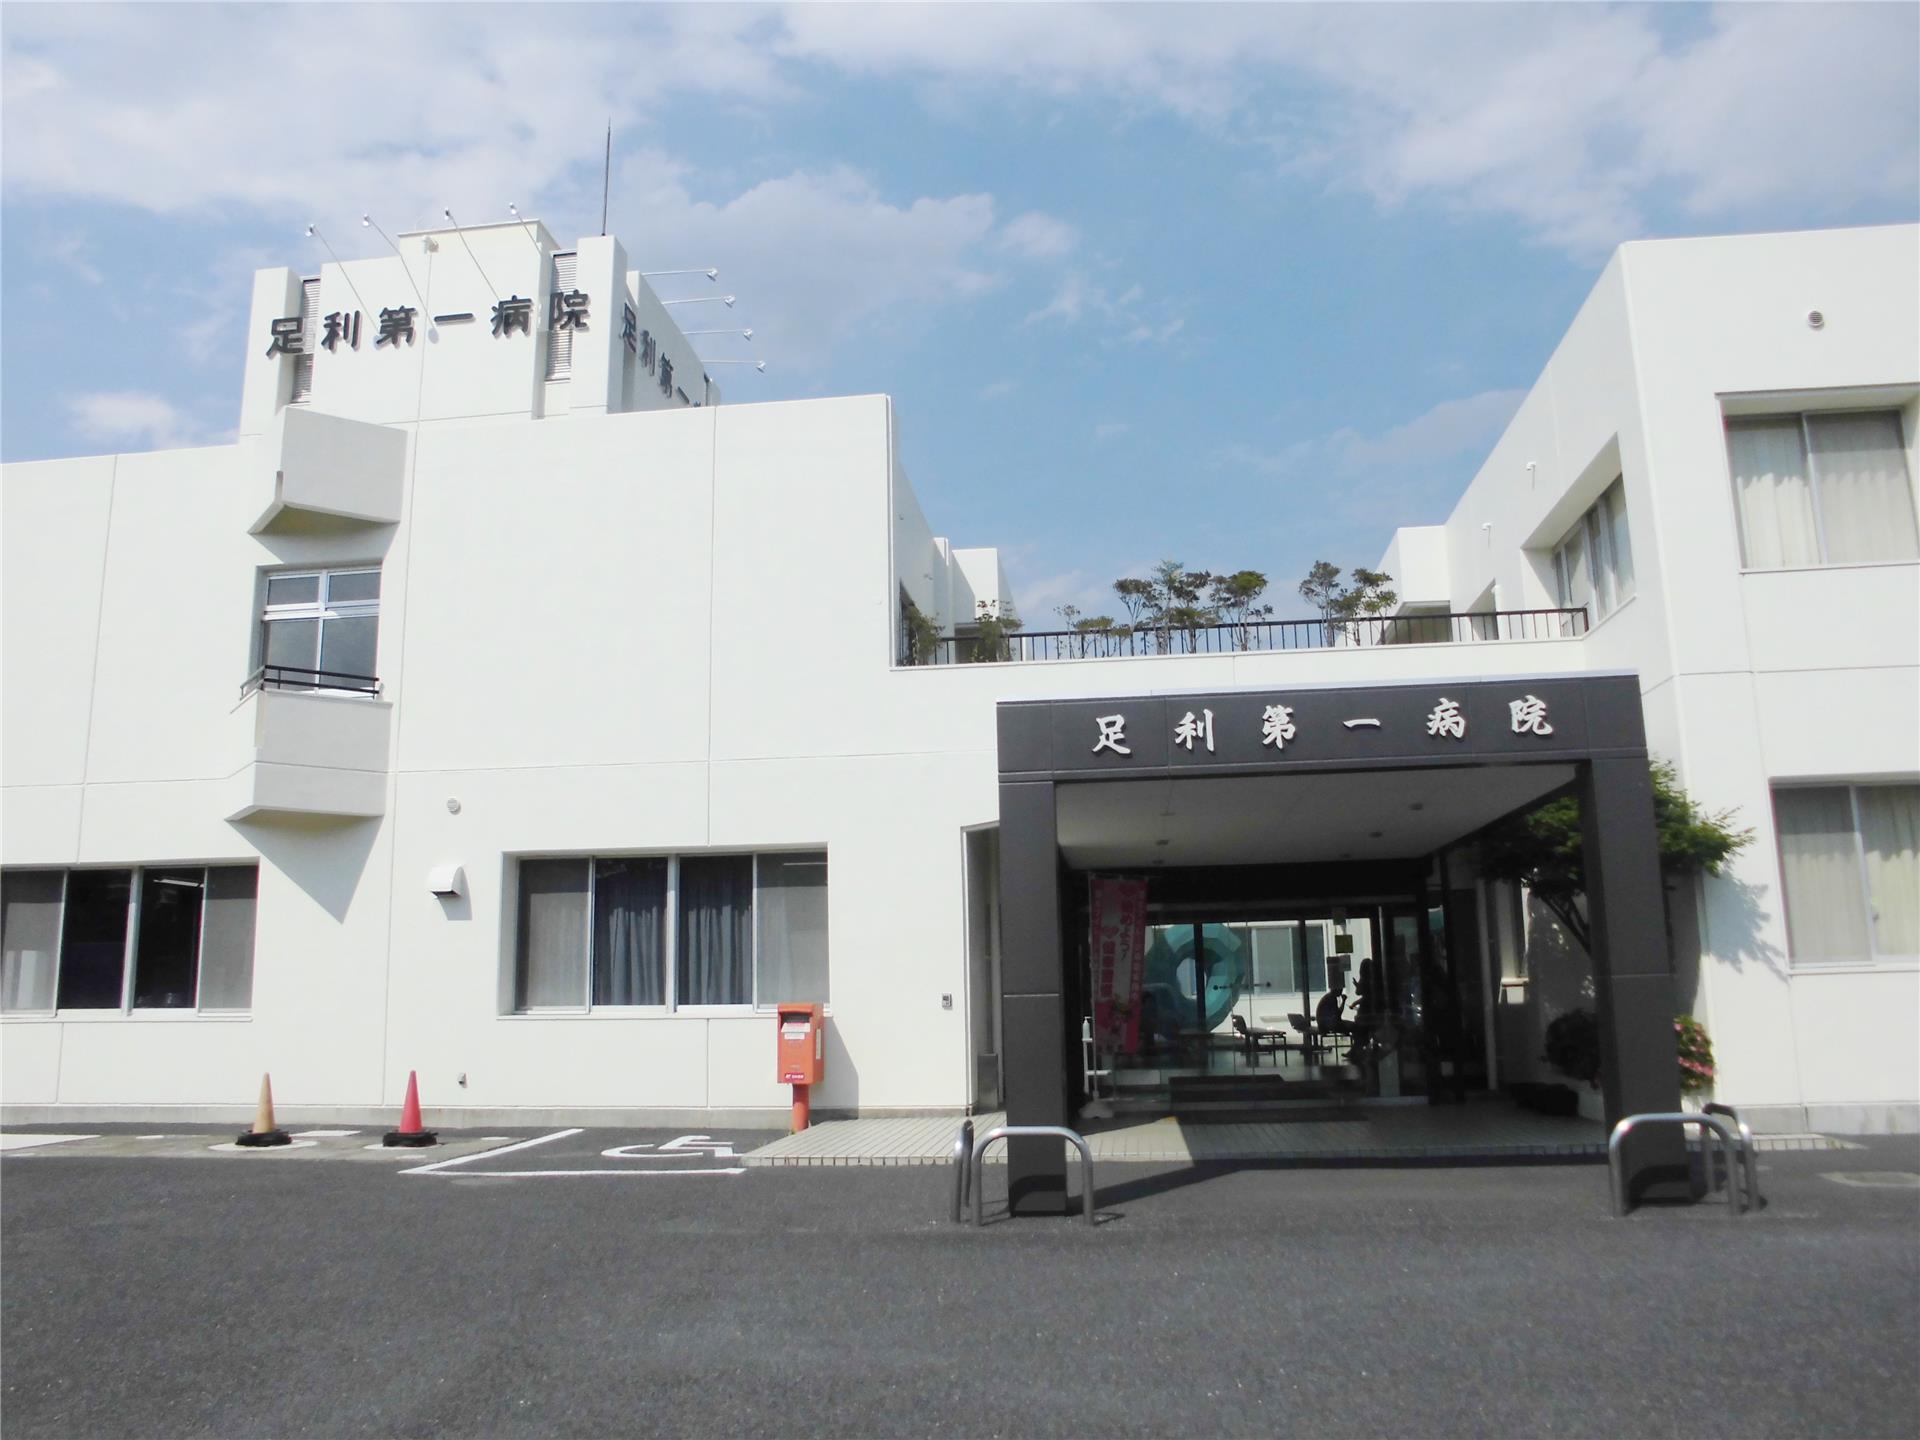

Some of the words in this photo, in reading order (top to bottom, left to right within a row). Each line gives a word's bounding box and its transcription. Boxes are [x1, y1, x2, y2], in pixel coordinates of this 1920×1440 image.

[266, 289, 591, 358] 足利第一病院
[622, 302, 702, 408] 足利第一
[1092, 694, 1554, 756] 足利第一病院
